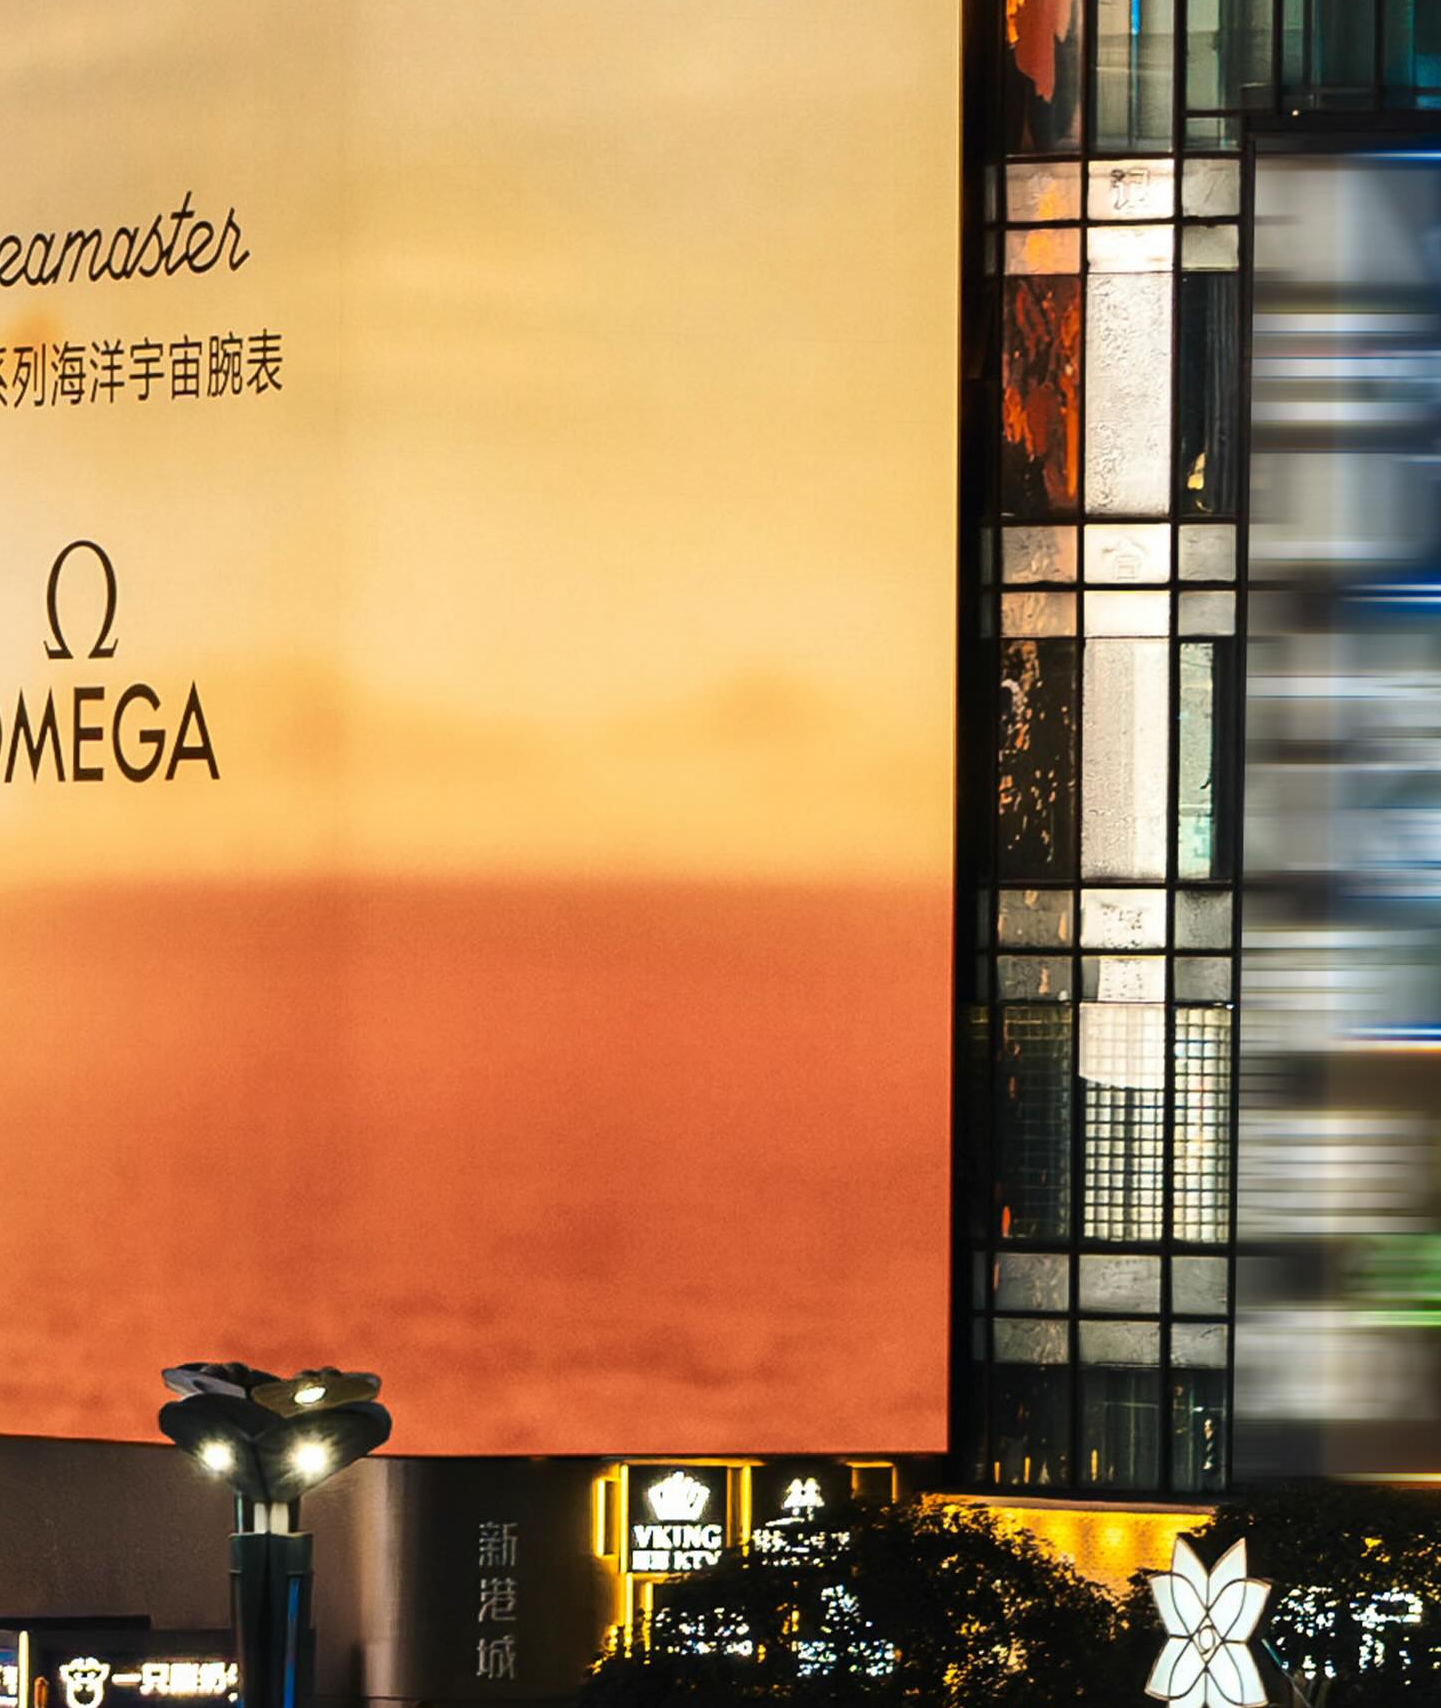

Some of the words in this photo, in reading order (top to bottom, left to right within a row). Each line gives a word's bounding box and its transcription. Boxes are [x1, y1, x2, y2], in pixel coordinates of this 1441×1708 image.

[633, 1524, 722, 1549] VKING
[476, 1520, 518, 1681] 新港城
